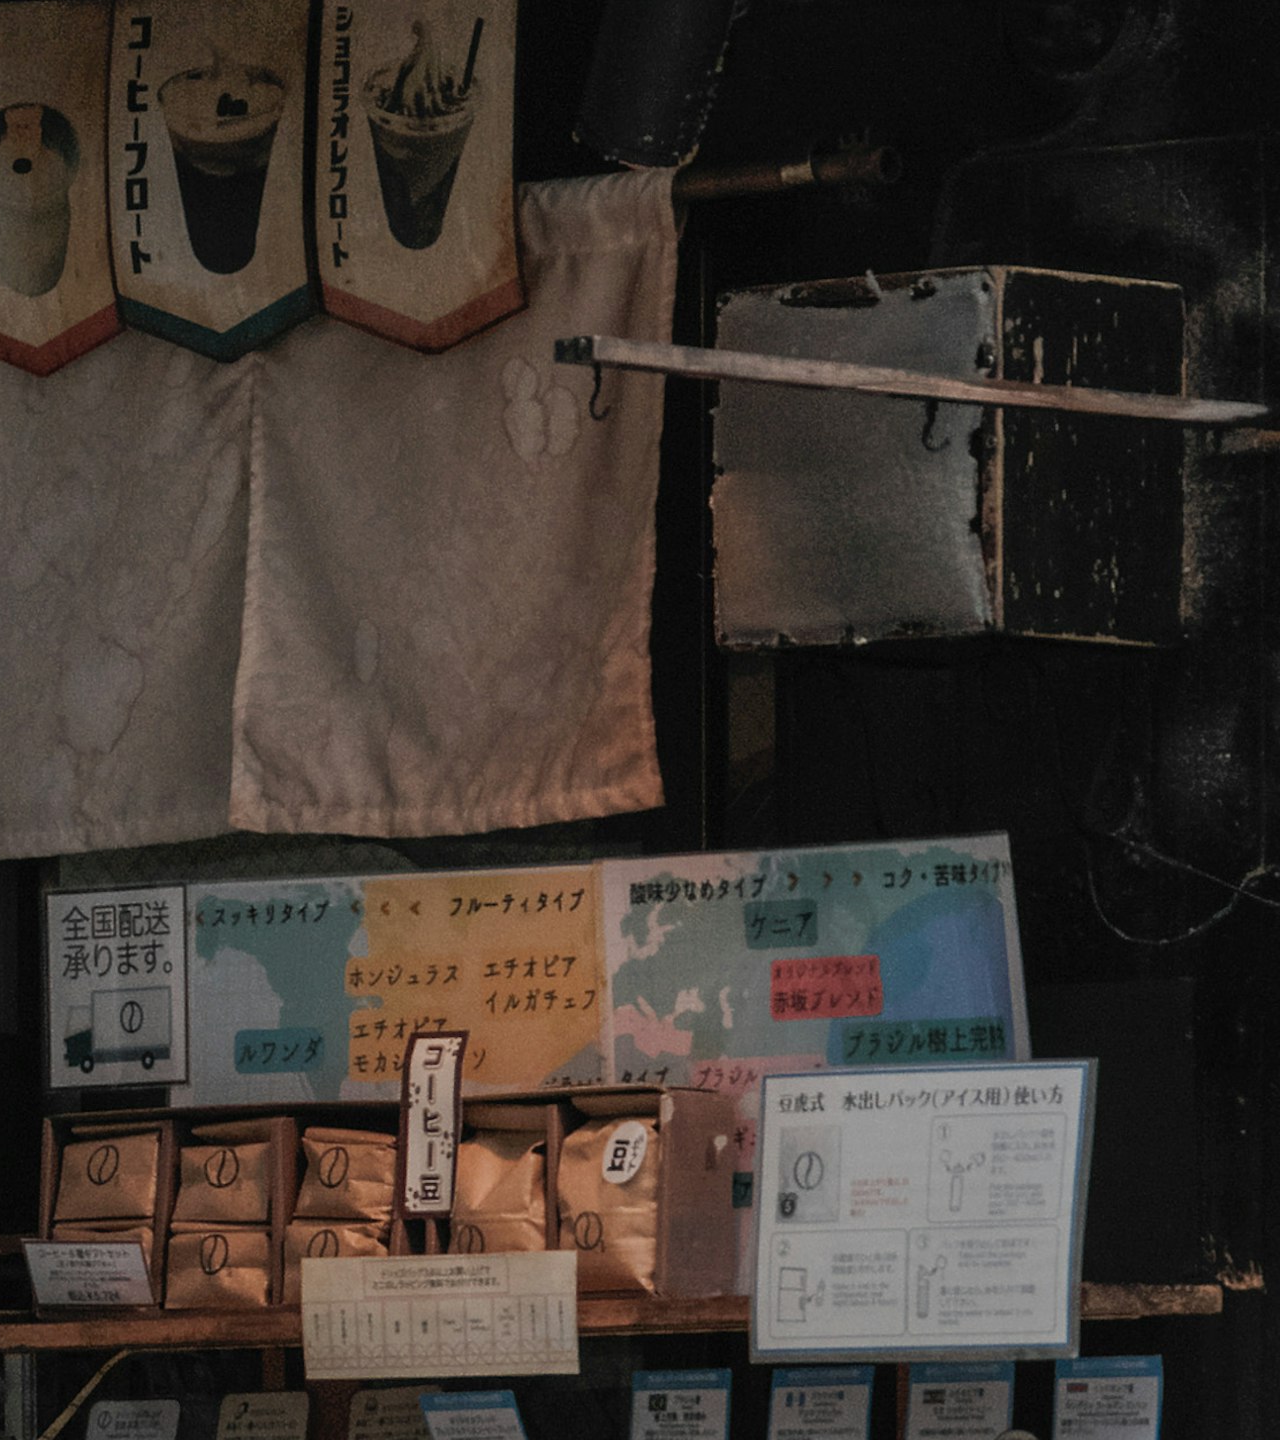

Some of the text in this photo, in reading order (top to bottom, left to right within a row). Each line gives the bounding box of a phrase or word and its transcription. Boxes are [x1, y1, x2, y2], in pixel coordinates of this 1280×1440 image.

[127, 17, 153, 275] コーヒーフロート
[61, 901, 171, 942] 全国配送
[211, 900, 332, 927] スッキリタイプ
[61, 941, 173, 979] 承ります。
[349, 963, 460, 987] ホンジュラス
[483, 954, 576, 980] エチオピア
[778, 1091, 826, 1113] 豆虎式
[421, 1046, 443, 1204] コーヒー豆
